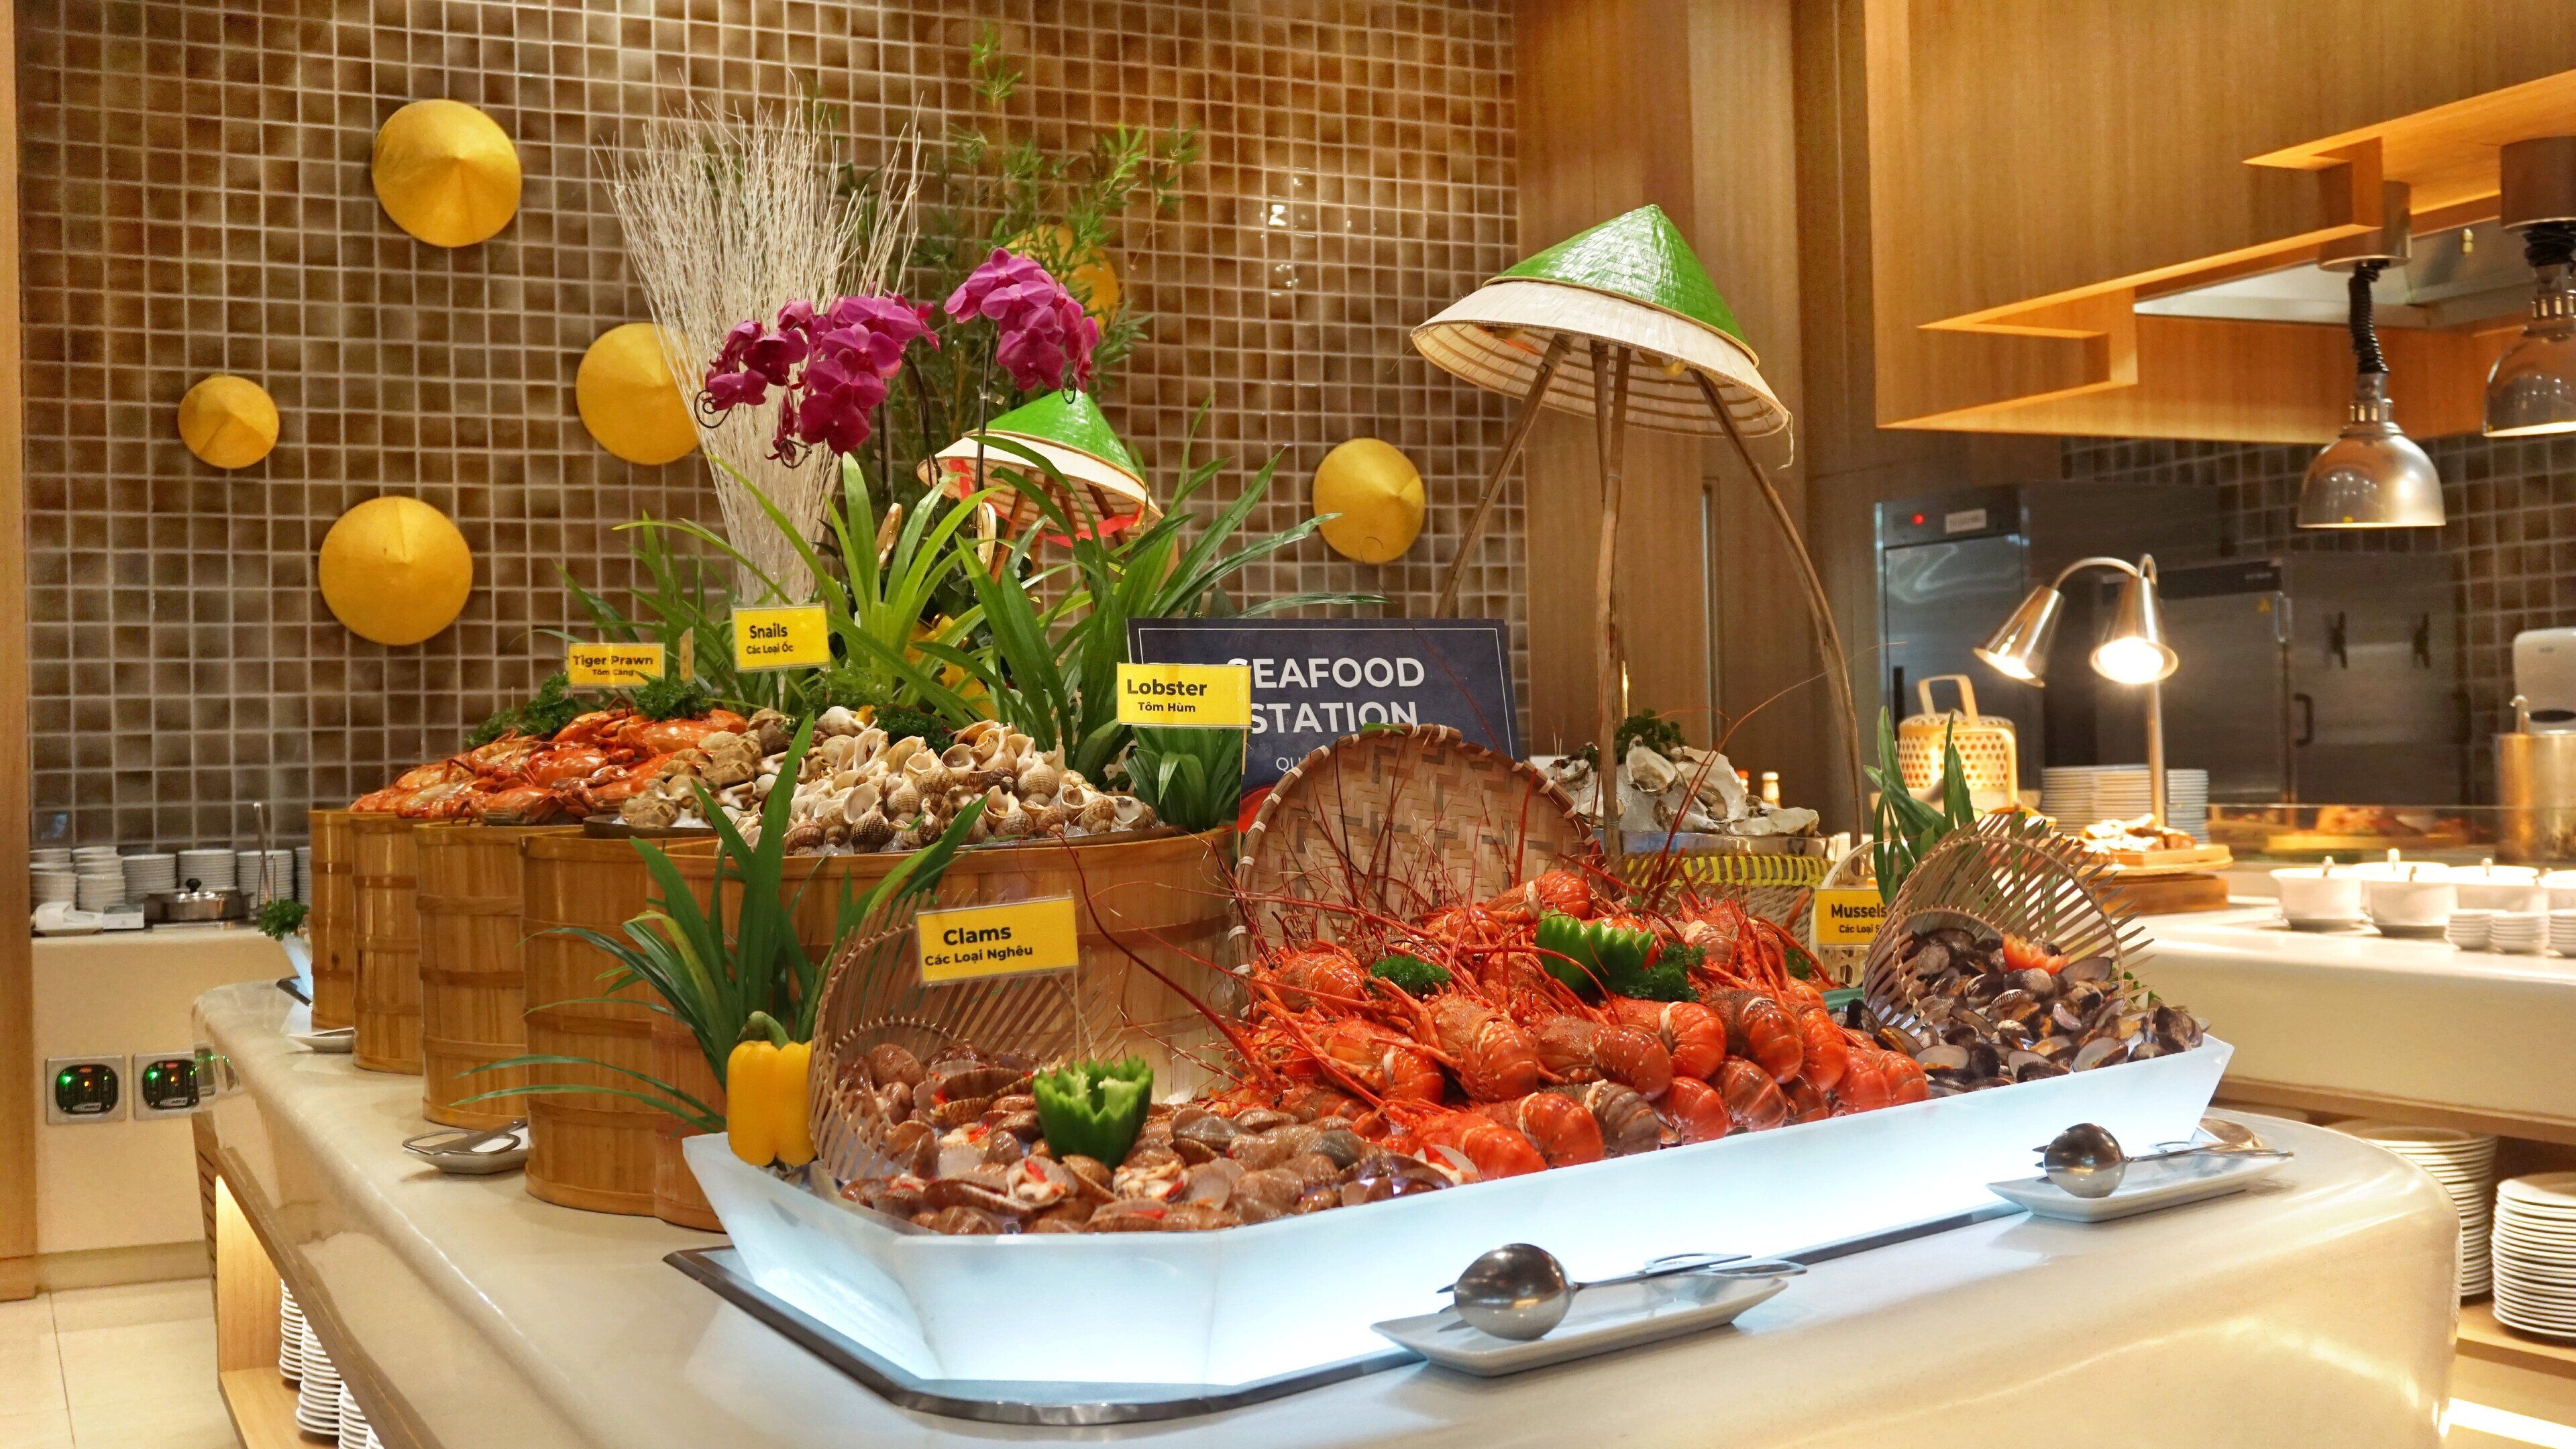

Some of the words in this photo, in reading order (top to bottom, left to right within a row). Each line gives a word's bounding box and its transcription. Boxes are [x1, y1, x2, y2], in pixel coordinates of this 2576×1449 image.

[749, 623, 788, 639] Snails
[747, 645, 761, 654] Các
[763, 643, 780, 655] Loại
[573, 655, 606, 667] Tiger
[611, 656, 653, 665] Prawn
[1227, 657, 1425, 688] EAFOOD
[1127, 679, 1208, 696] Lobster
[1138, 702, 1164, 711] Tôm
[1168, 702, 1195, 712] Hùm
[1251, 702, 1417, 734] STATION
[1831, 903, 1888, 918] Mussels
[943, 926, 1012, 946] Clams
[1839, 924, 1854, 933] Các
[1857, 924, 1874, 934] Loại
[925, 954, 951, 967] Các
[955, 949, 983, 964] Loại
[987, 945, 1033, 961] Nghêu
